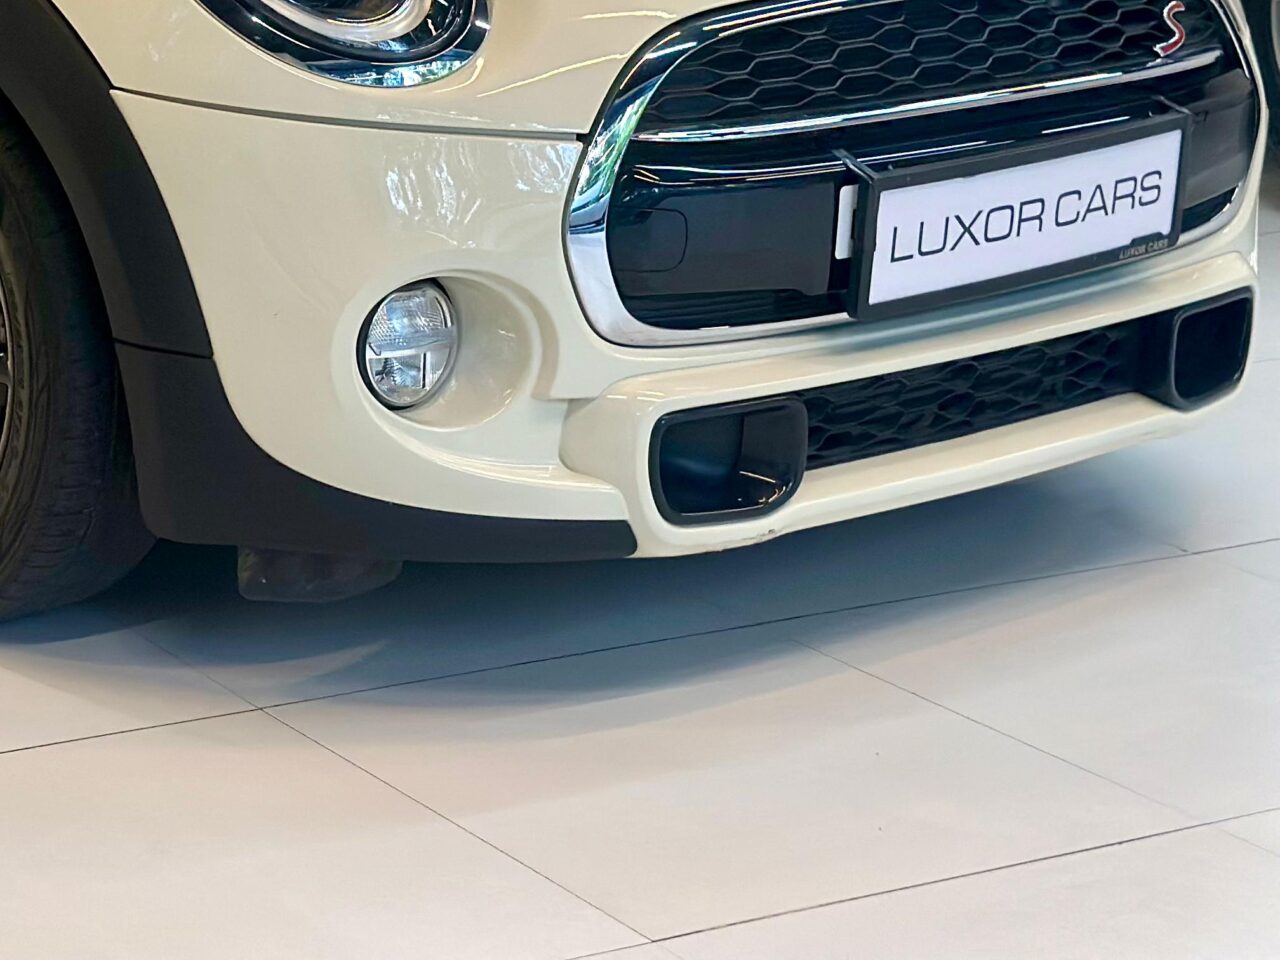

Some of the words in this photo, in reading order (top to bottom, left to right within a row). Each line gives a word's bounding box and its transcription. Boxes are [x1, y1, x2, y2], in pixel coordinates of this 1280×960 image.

[1153, 0, 1185, 57] S
[890, 197, 1046, 263] LUXOR
[1055, 170, 1162, 227] CARS
